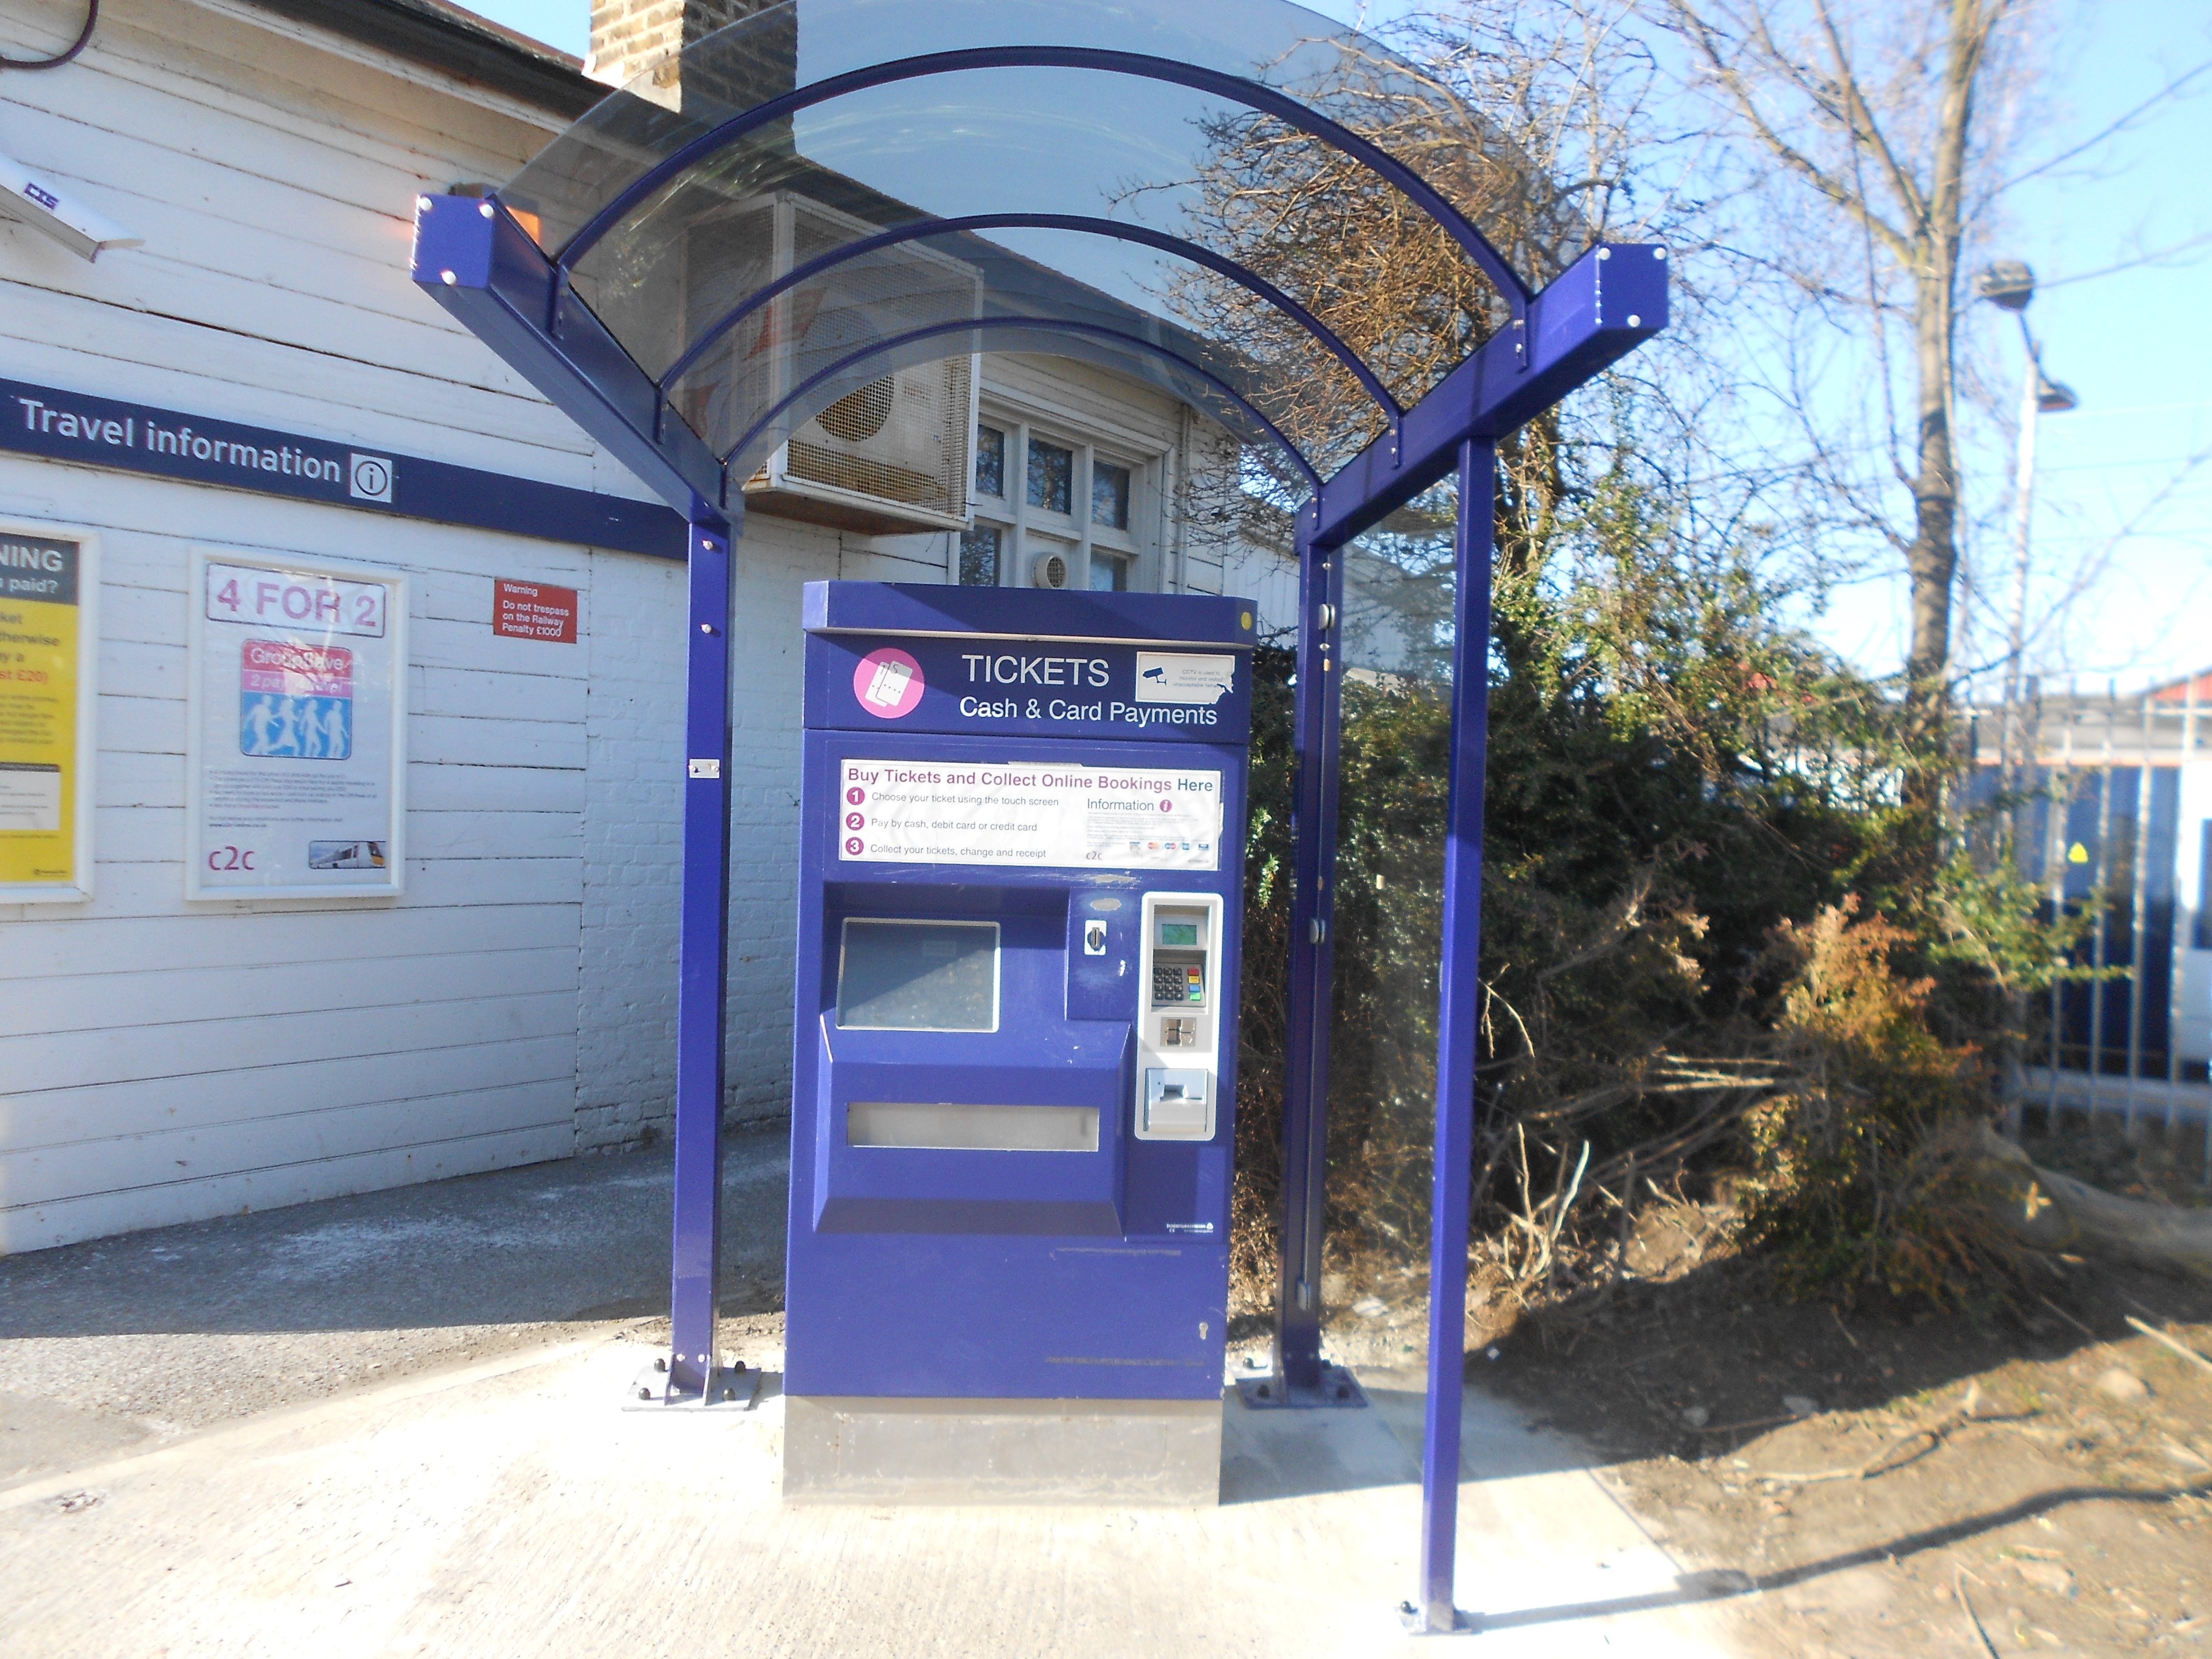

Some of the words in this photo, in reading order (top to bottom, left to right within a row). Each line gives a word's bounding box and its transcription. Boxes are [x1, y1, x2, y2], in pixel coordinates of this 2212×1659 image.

[19, 398, 133, 448] Travel
[147, 421, 340, 483] information
[9, 578, 58, 593] paid?
[503, 583, 538, 598] Warning
[217, 579, 241, 612] 4
[257, 582, 341, 624] FOR
[355, 595, 376, 627] 2
[503, 600, 515, 609] Do
[517, 603, 531, 612] not
[534, 604, 569, 616] trespass
[516, 613, 530, 623] the
[533, 614, 564, 628] Railway
[502, 623, 535, 635] Penalty
[537, 627, 562, 637] £1000
[962, 654, 1110, 687] TICKETS
[960, 696, 1017, 718] Cash
[1025, 698, 1041, 719] &
[1049, 699, 1101, 721] Card
[1110, 701, 1218, 728] Payments
[848, 768, 879, 784] Buy
[884, 769, 941, 783] Tickets
[947, 772, 975, 784] and
[981, 772, 1036, 786] Collect
[1042, 774, 1093, 788] Online
[1098, 776, 1172, 794] Bookings
[1178, 778, 1213, 791] Here
[852, 790, 859, 802] 1
[872, 792, 906, 801] Choose
[932, 794, 955, 803] ticket
[958, 796, 982, 805] using
[985, 796, 999, 804] the
[1002, 797, 1026, 805] touch
[1087, 798, 1154, 811] Information
[850, 815, 861, 827] 2
[871, 818, 888, 828] Pay
[891, 819, 902, 829] by
[904, 820, 928, 829] cash,
[931, 820, 953, 829] debit
[956, 821, 976, 830] card
[990, 822, 1015, 831] credit
[849, 839, 860, 853] 3
[870, 844, 901, 853] Collect
[904, 847, 924, 855] your
[926, 846, 958, 856] tickets,
[960, 847, 993, 858] change
[1016, 849, 1046, 859] receipt
[208, 845, 254, 870] c2c
[1086, 851, 1102, 860] c2c
